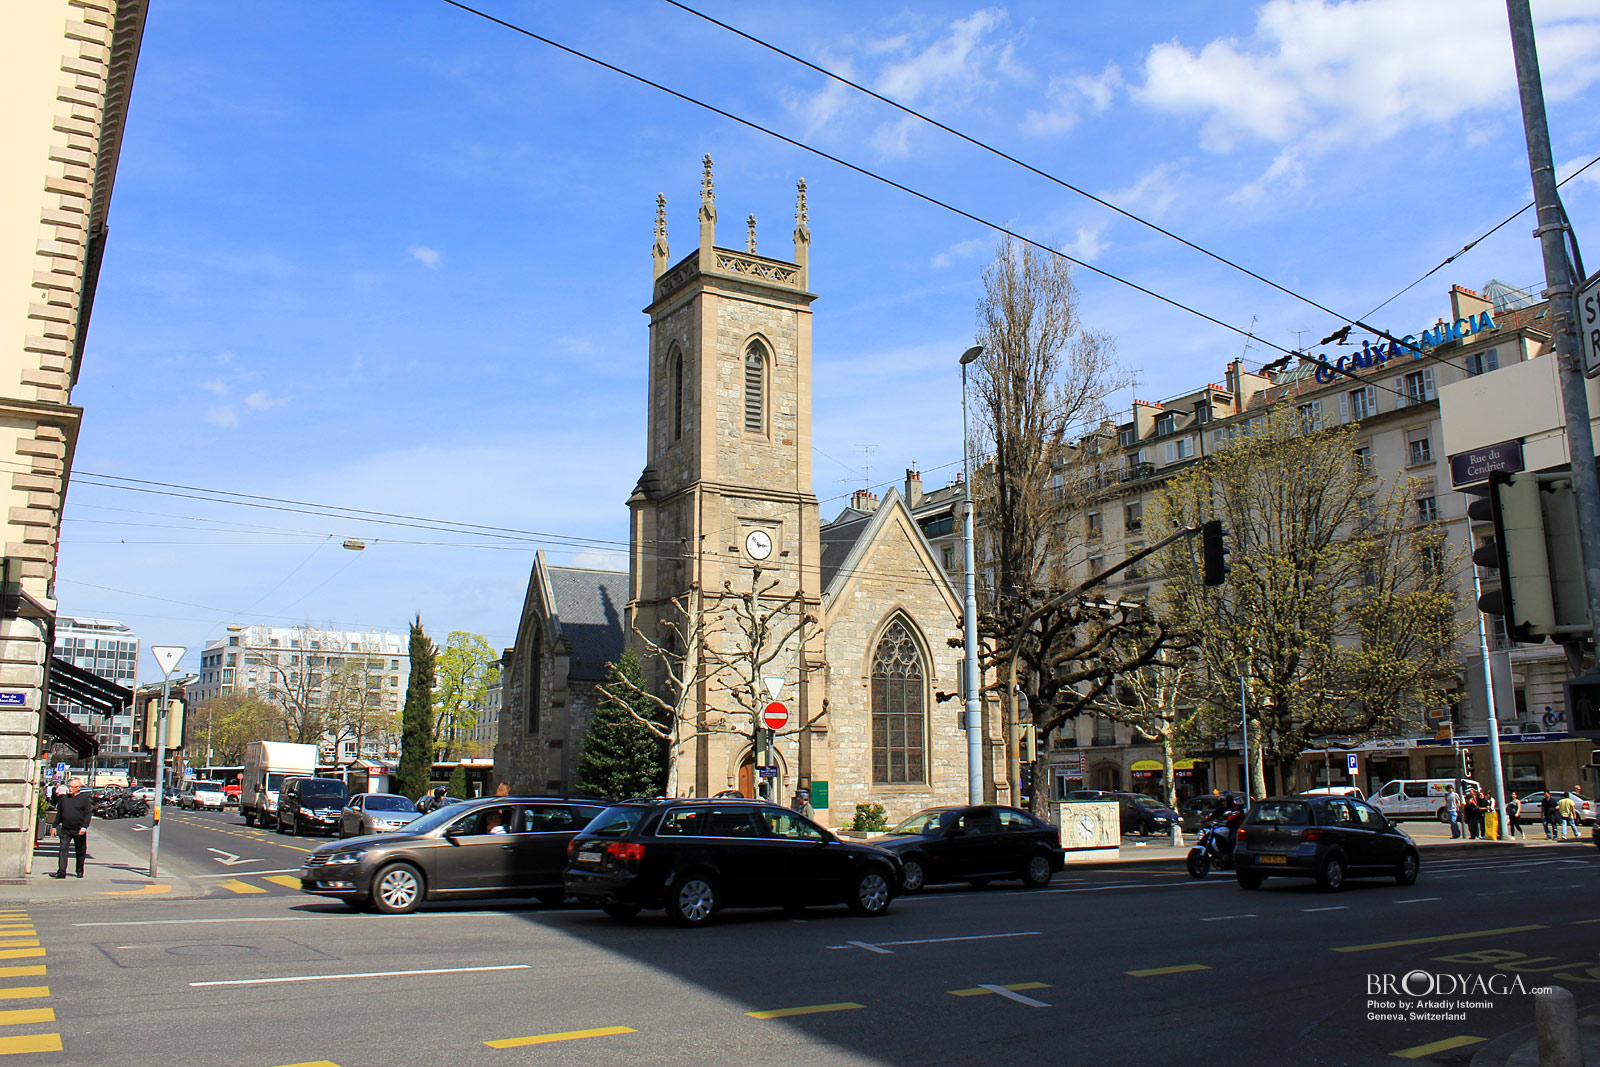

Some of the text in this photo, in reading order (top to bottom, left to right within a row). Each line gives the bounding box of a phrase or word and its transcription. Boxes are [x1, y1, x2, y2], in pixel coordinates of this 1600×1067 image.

[1470, 450, 1500, 464] Rue du
[1467, 461, 1505, 476] Cendrier
